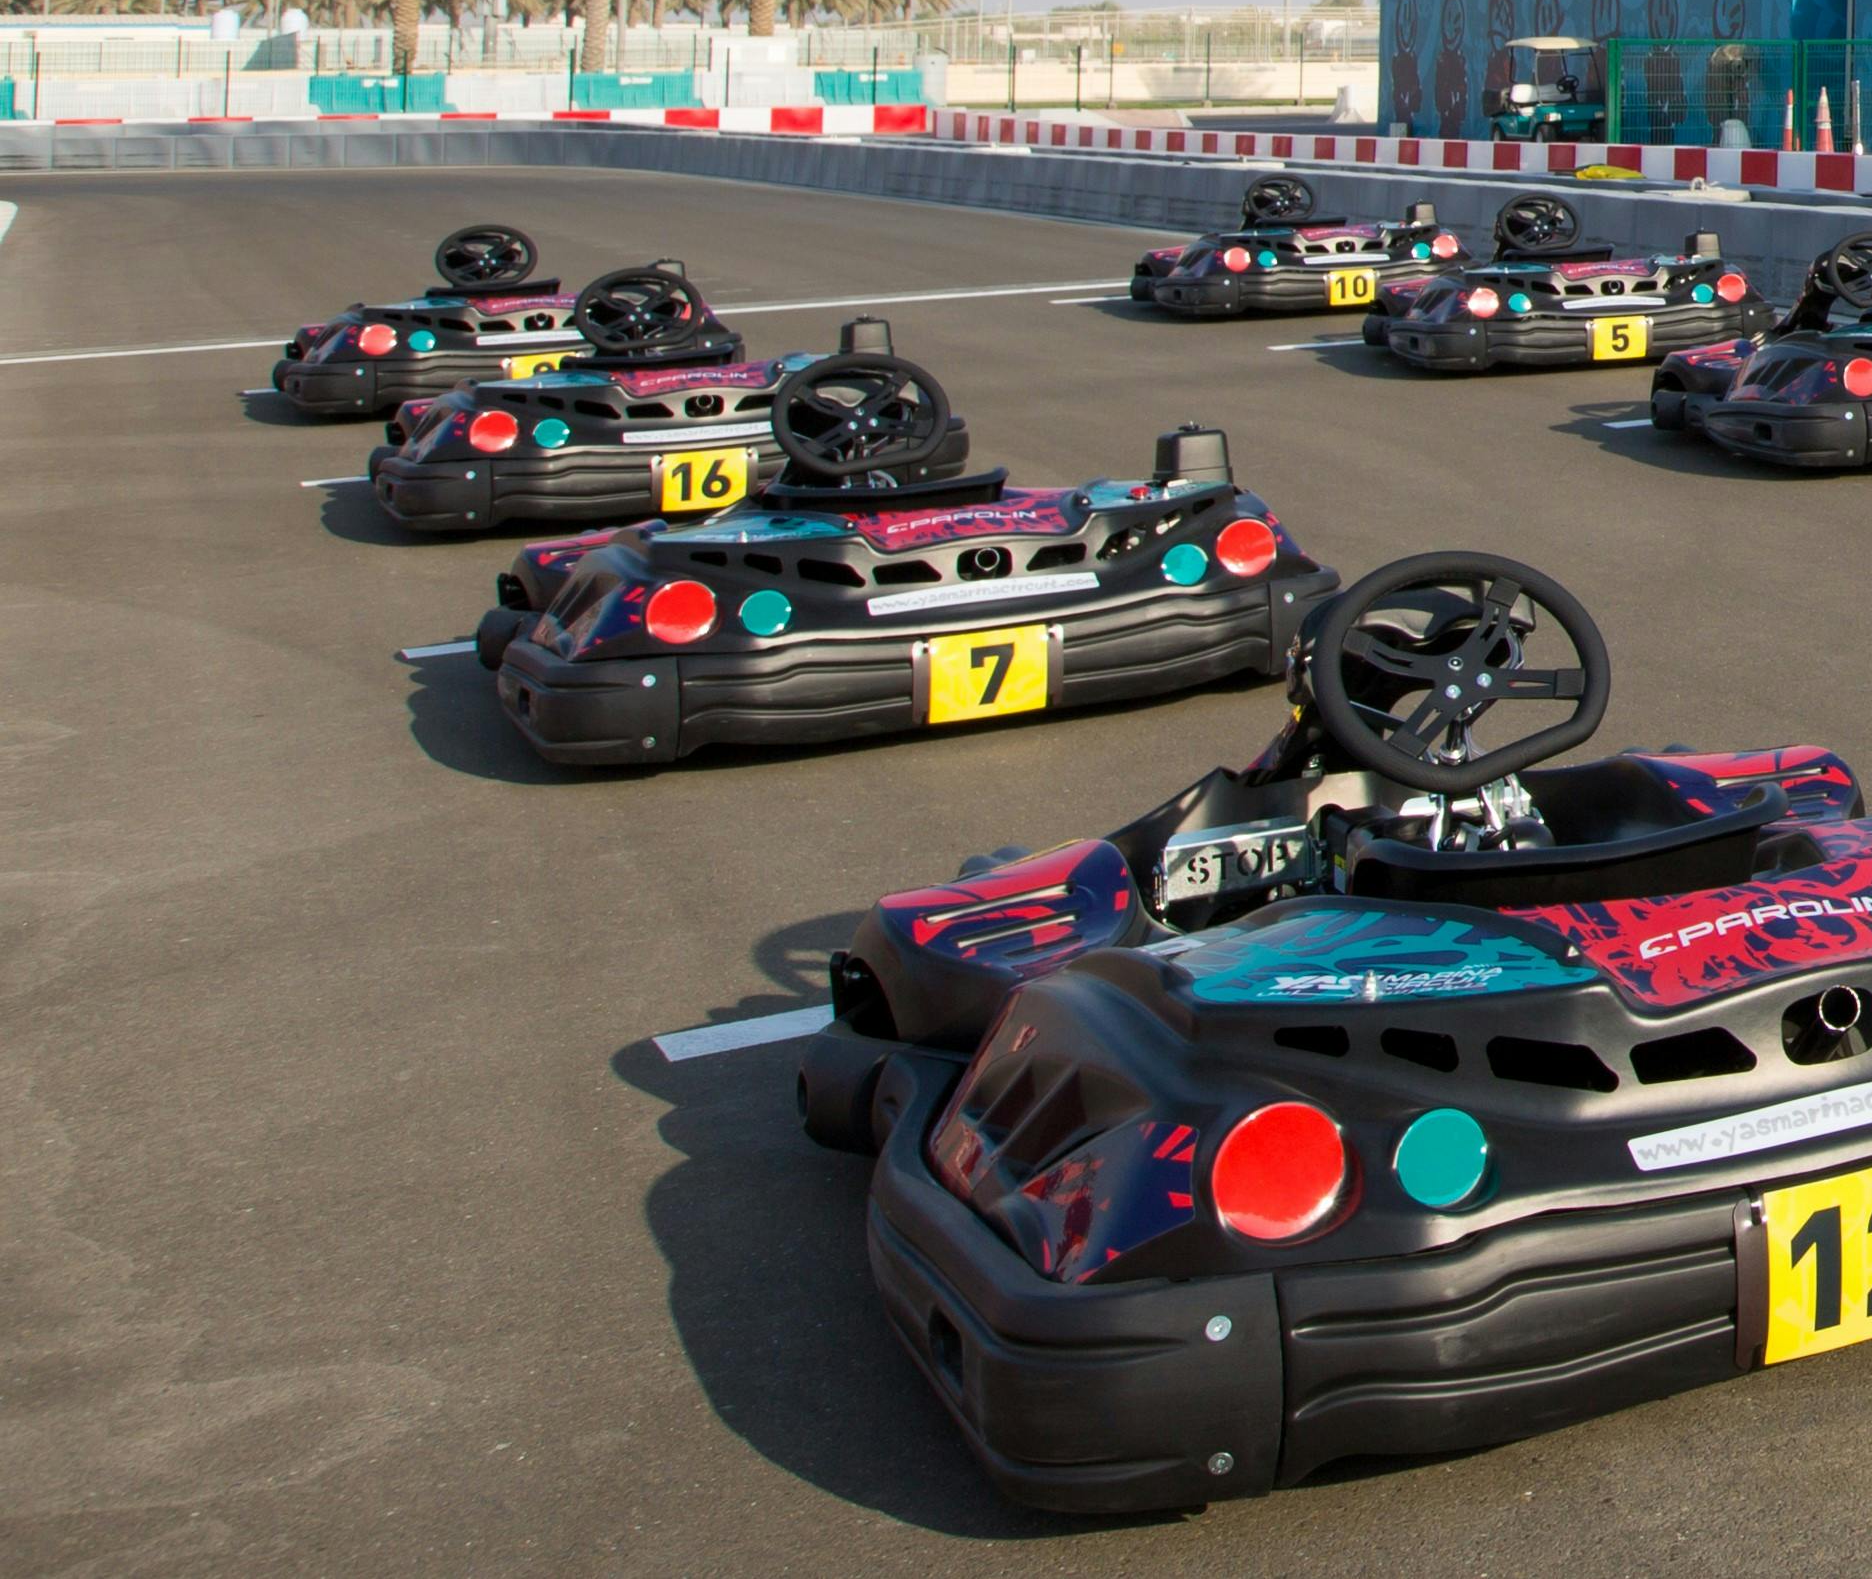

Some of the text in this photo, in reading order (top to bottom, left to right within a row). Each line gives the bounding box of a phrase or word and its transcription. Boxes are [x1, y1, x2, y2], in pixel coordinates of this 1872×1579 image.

[1336, 275, 1368, 299] 10
[1612, 324, 1630, 352] 5
[671, 458, 732, 501] 16
[969, 643, 1015, 706] 7
[1187, 842, 1291, 885] STOP
